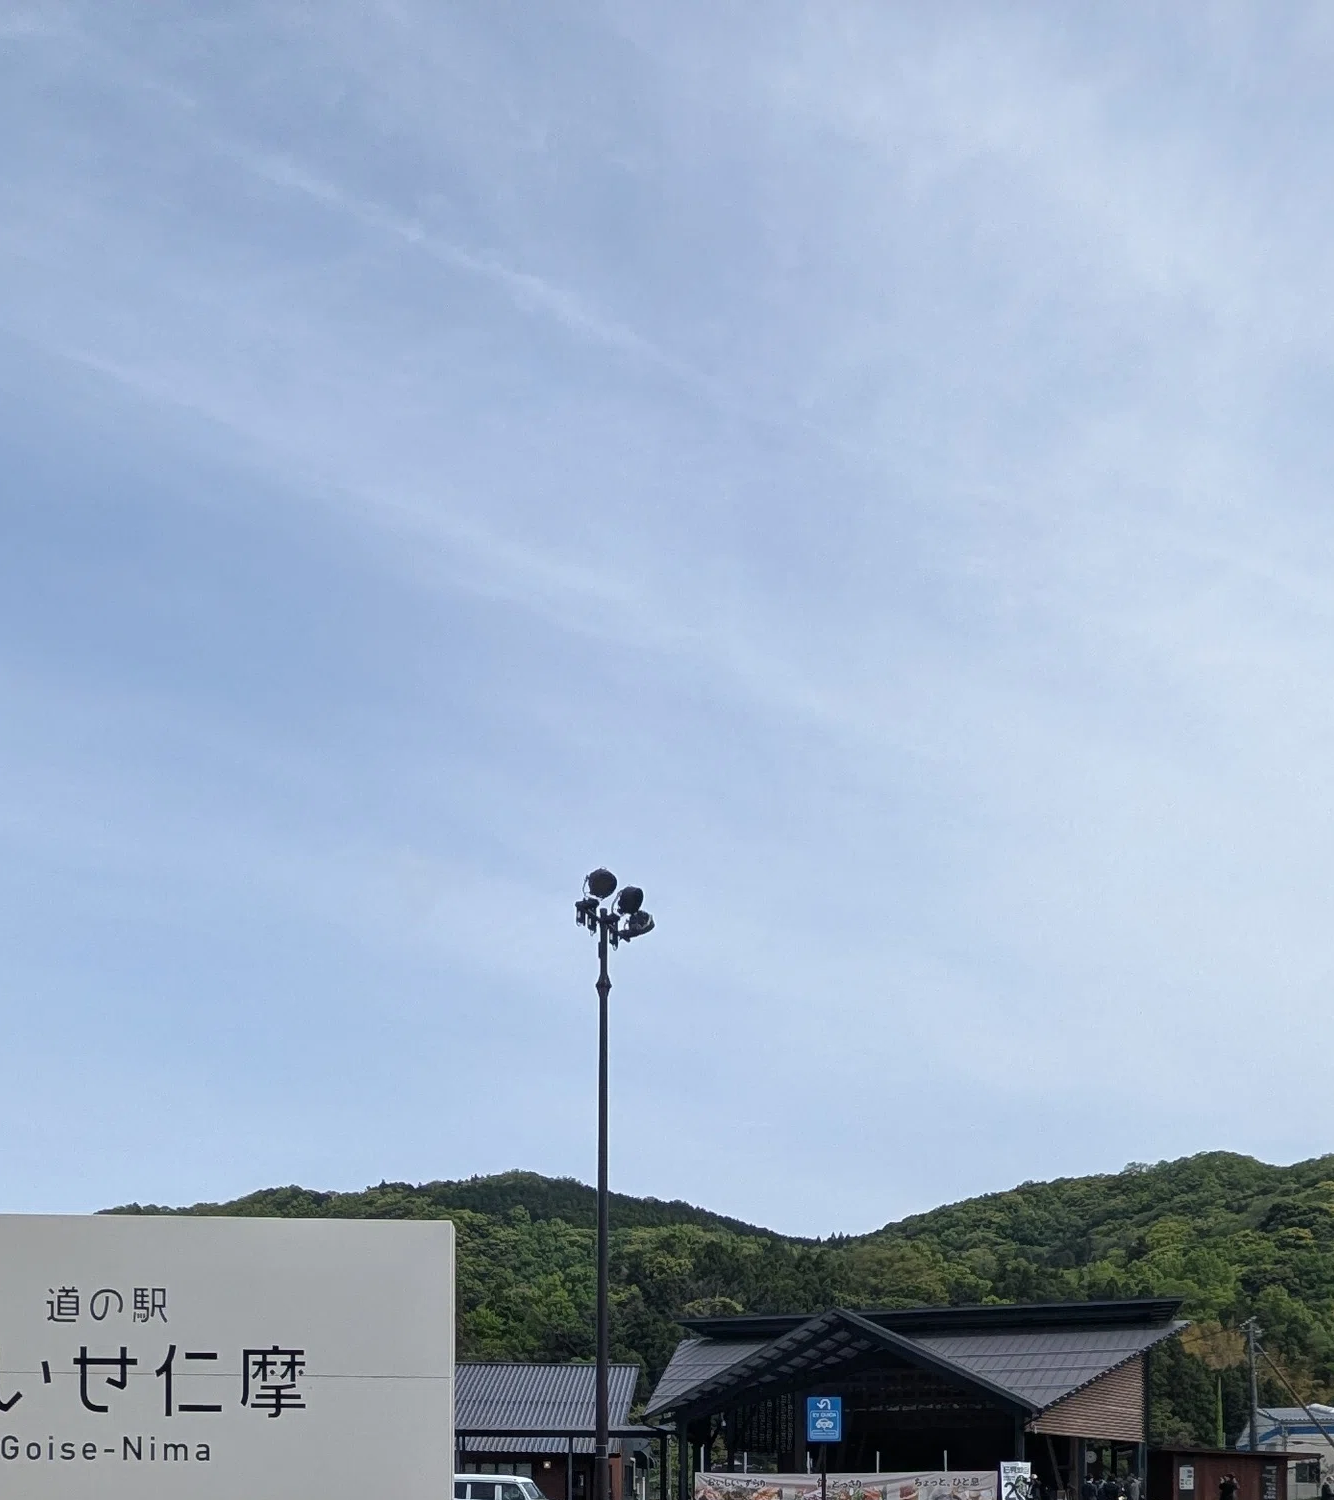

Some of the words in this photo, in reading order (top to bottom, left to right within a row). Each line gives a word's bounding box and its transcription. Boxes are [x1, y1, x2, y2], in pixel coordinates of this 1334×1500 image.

[46, 1286, 168, 1323] 道の駅
[0, 1435, 211, 1462] Goise-Nima
